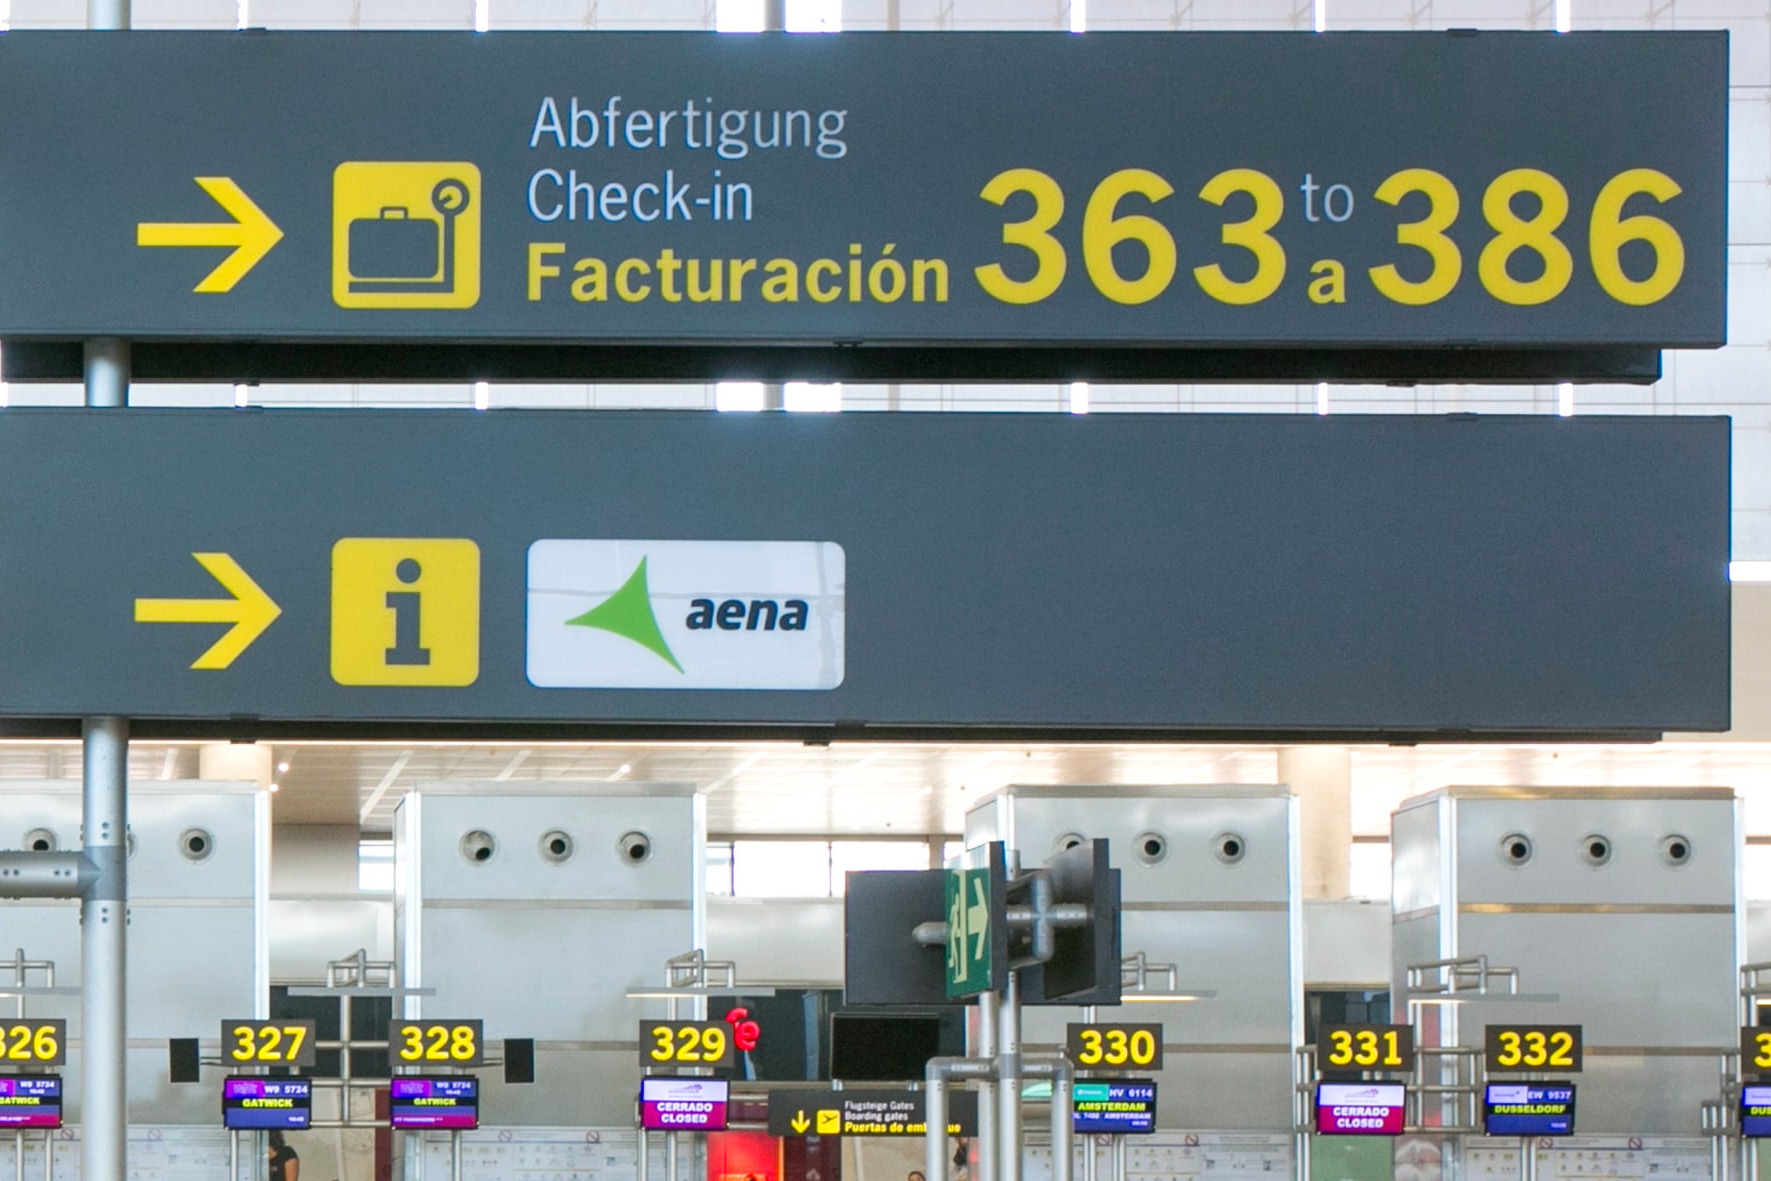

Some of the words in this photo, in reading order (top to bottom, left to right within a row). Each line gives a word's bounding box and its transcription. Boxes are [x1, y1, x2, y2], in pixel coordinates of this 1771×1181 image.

[530, 96, 848, 159] Abfertigung
[529, 168, 752, 221] Check-in
[1301, 173, 1354, 222] to
[527, 244, 946, 303] Facturación
[974, 170, 1284, 305] 363
[1307, 261, 1344, 304] a
[1369, 169, 1683, 305] 386
[686, 599, 808, 631] aena
[233, 1026, 306, 1060] 327
[400, 1026, 475, 1060] 328
[651, 1026, 726, 1061] 329
[1079, 1030, 1155, 1064] 330
[1330, 1031, 1402, 1065] 331
[1498, 1032, 1573, 1065] 332
[284, 1085, 308, 1094] 5724
[1128, 1088, 1153, 1098] 6114
[242, 1098, 293, 1108] GATWICK
[413, 1097, 456, 1107] GATWICK
[656, 1102, 713, 1112] CERRADO
[845, 1101, 888, 1111] Flugsteige
[890, 1101, 915, 1111] Gates
[1078, 1102, 1146, 1112] AMSTERDAM
[1333, 1107, 1390, 1117] CERRADO
[1494, 1104, 1566, 1114] DUSSELDORF
[660, 1113, 708, 1124] CLOSED
[845, 1111, 881, 1122] Boarding
[884, 1112, 909, 1122] gates
[844, 1122, 887, 1133] Puertas
[889, 1122, 904, 1133] de
[1336, 1118, 1384, 1129] CLOSED
